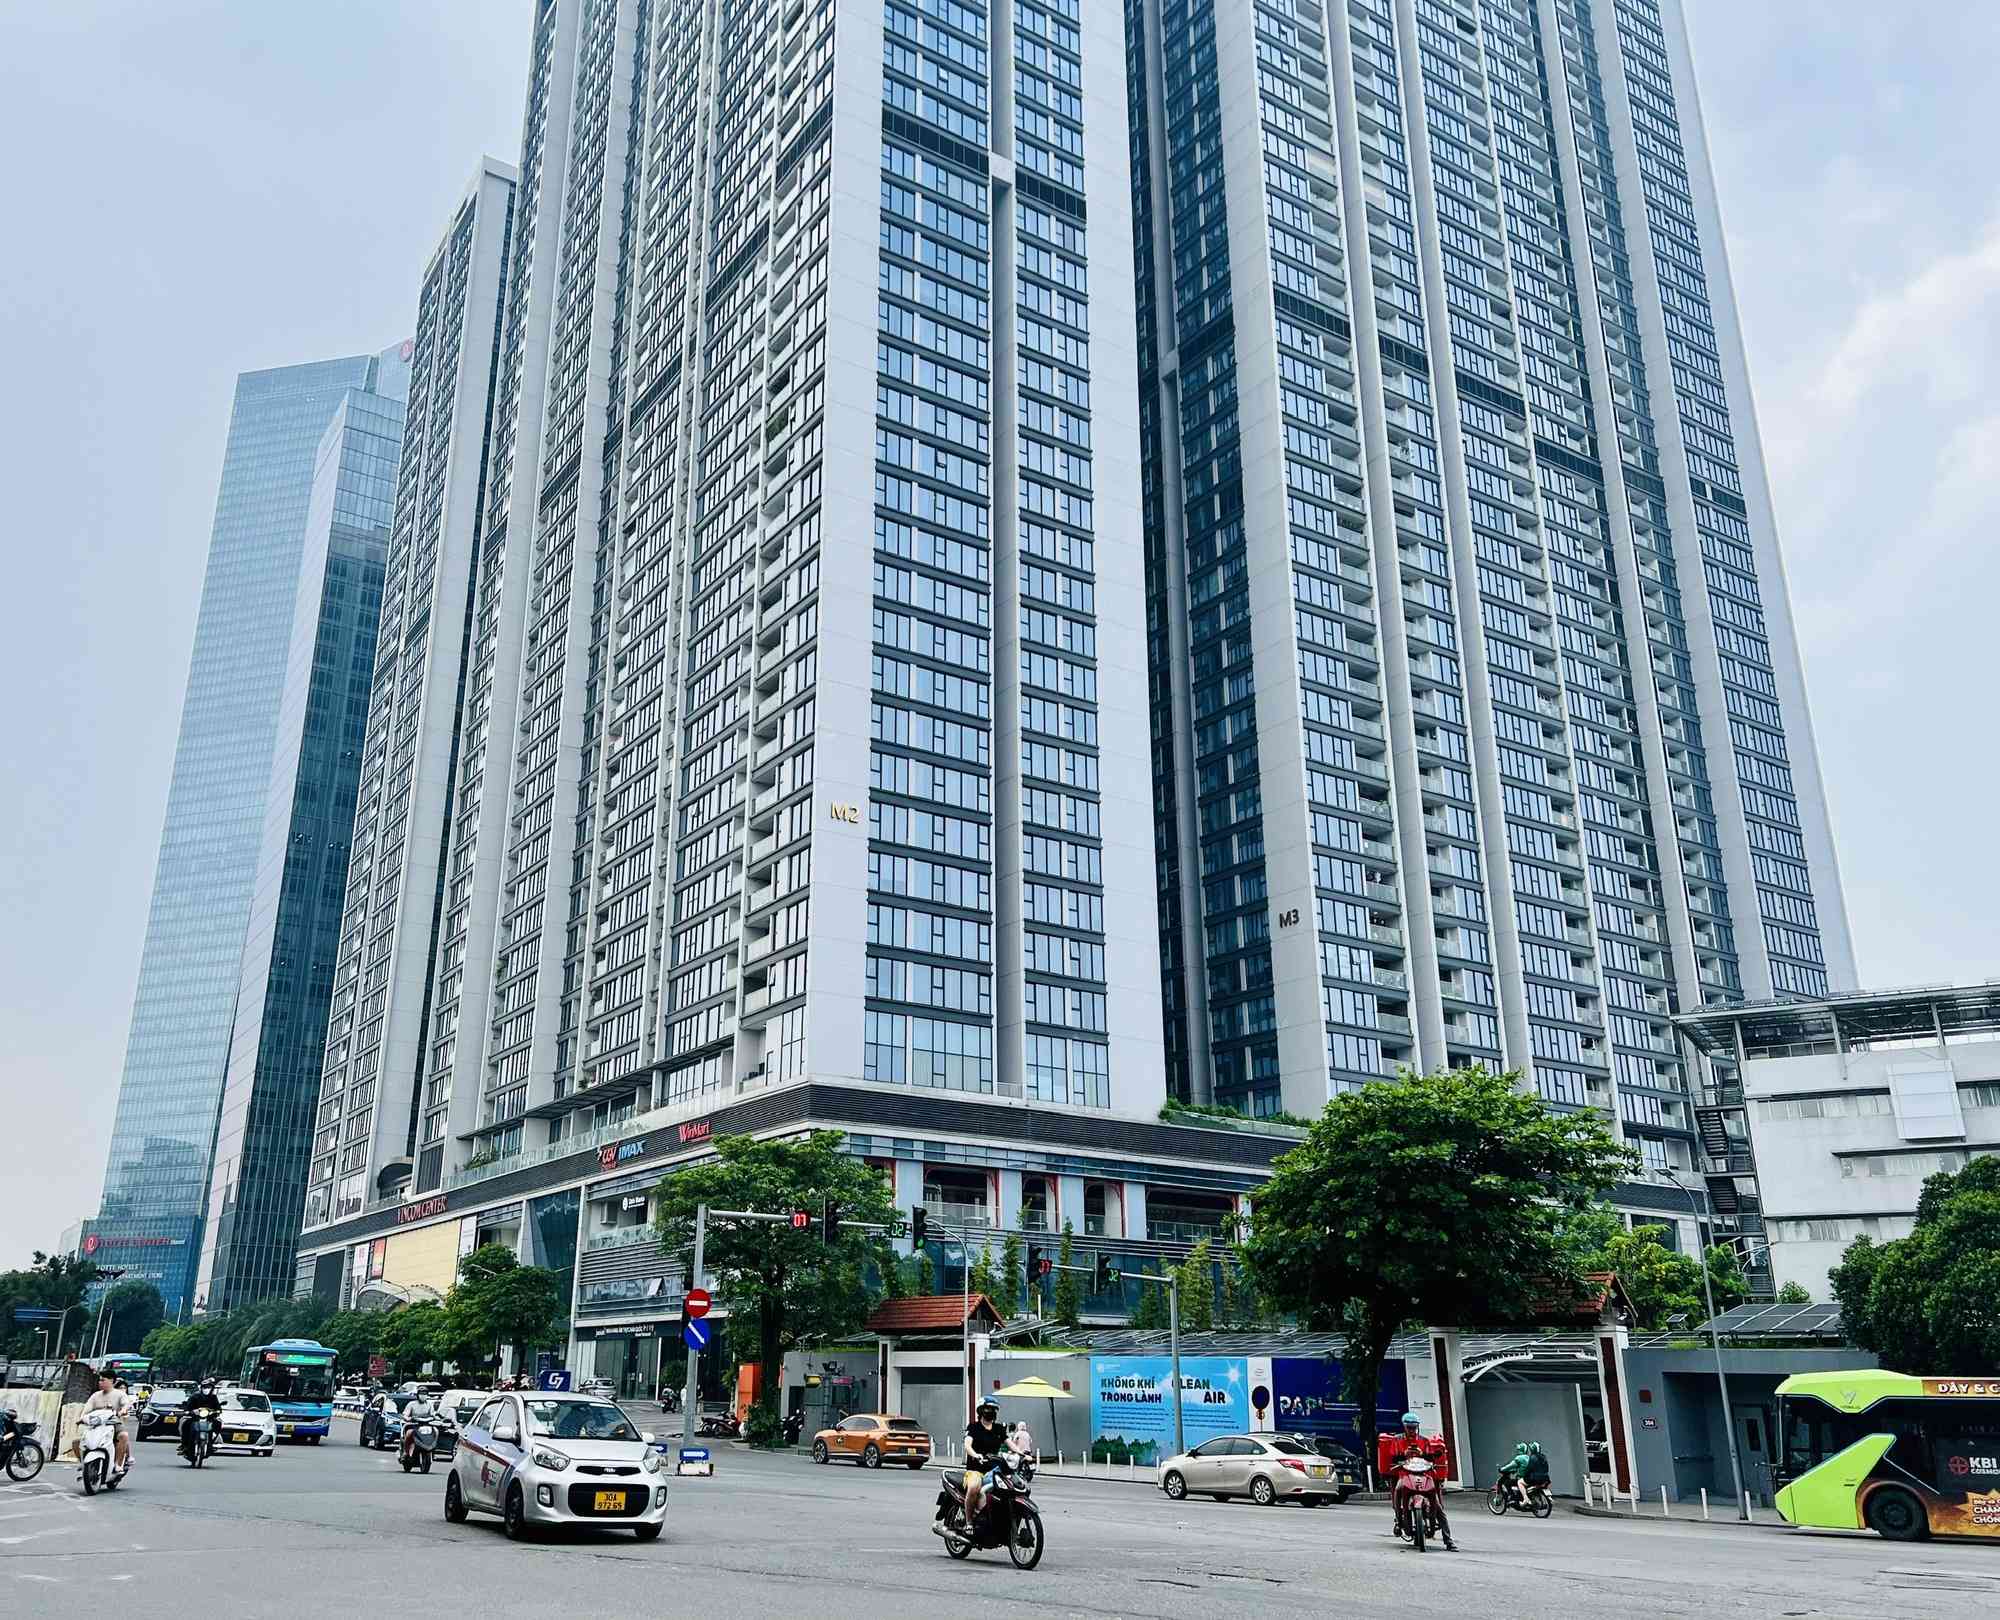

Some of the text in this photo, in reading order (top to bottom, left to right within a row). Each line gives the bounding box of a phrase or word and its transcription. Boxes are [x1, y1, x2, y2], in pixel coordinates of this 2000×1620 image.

[830, 801, 859, 823] M2
[1279, 909, 1300, 928] M3
[680, 1120, 710, 1142] WinMart
[618, 1140, 647, 1160] IMAX
[793, 1214, 807, 1228] 07
[890, 1223, 905, 1237] 02
[547, 1372, 564, 1390] G7
[1101, 1375, 1156, 1389] KHÔNG KHÍ
[1171, 1378, 1210, 1390] LEAN
[1101, 1389, 1162, 1404] TRONG LÀNH
[1203, 1391, 1226, 1404] AIR
[1969, 1457, 1998, 1468] KBI
